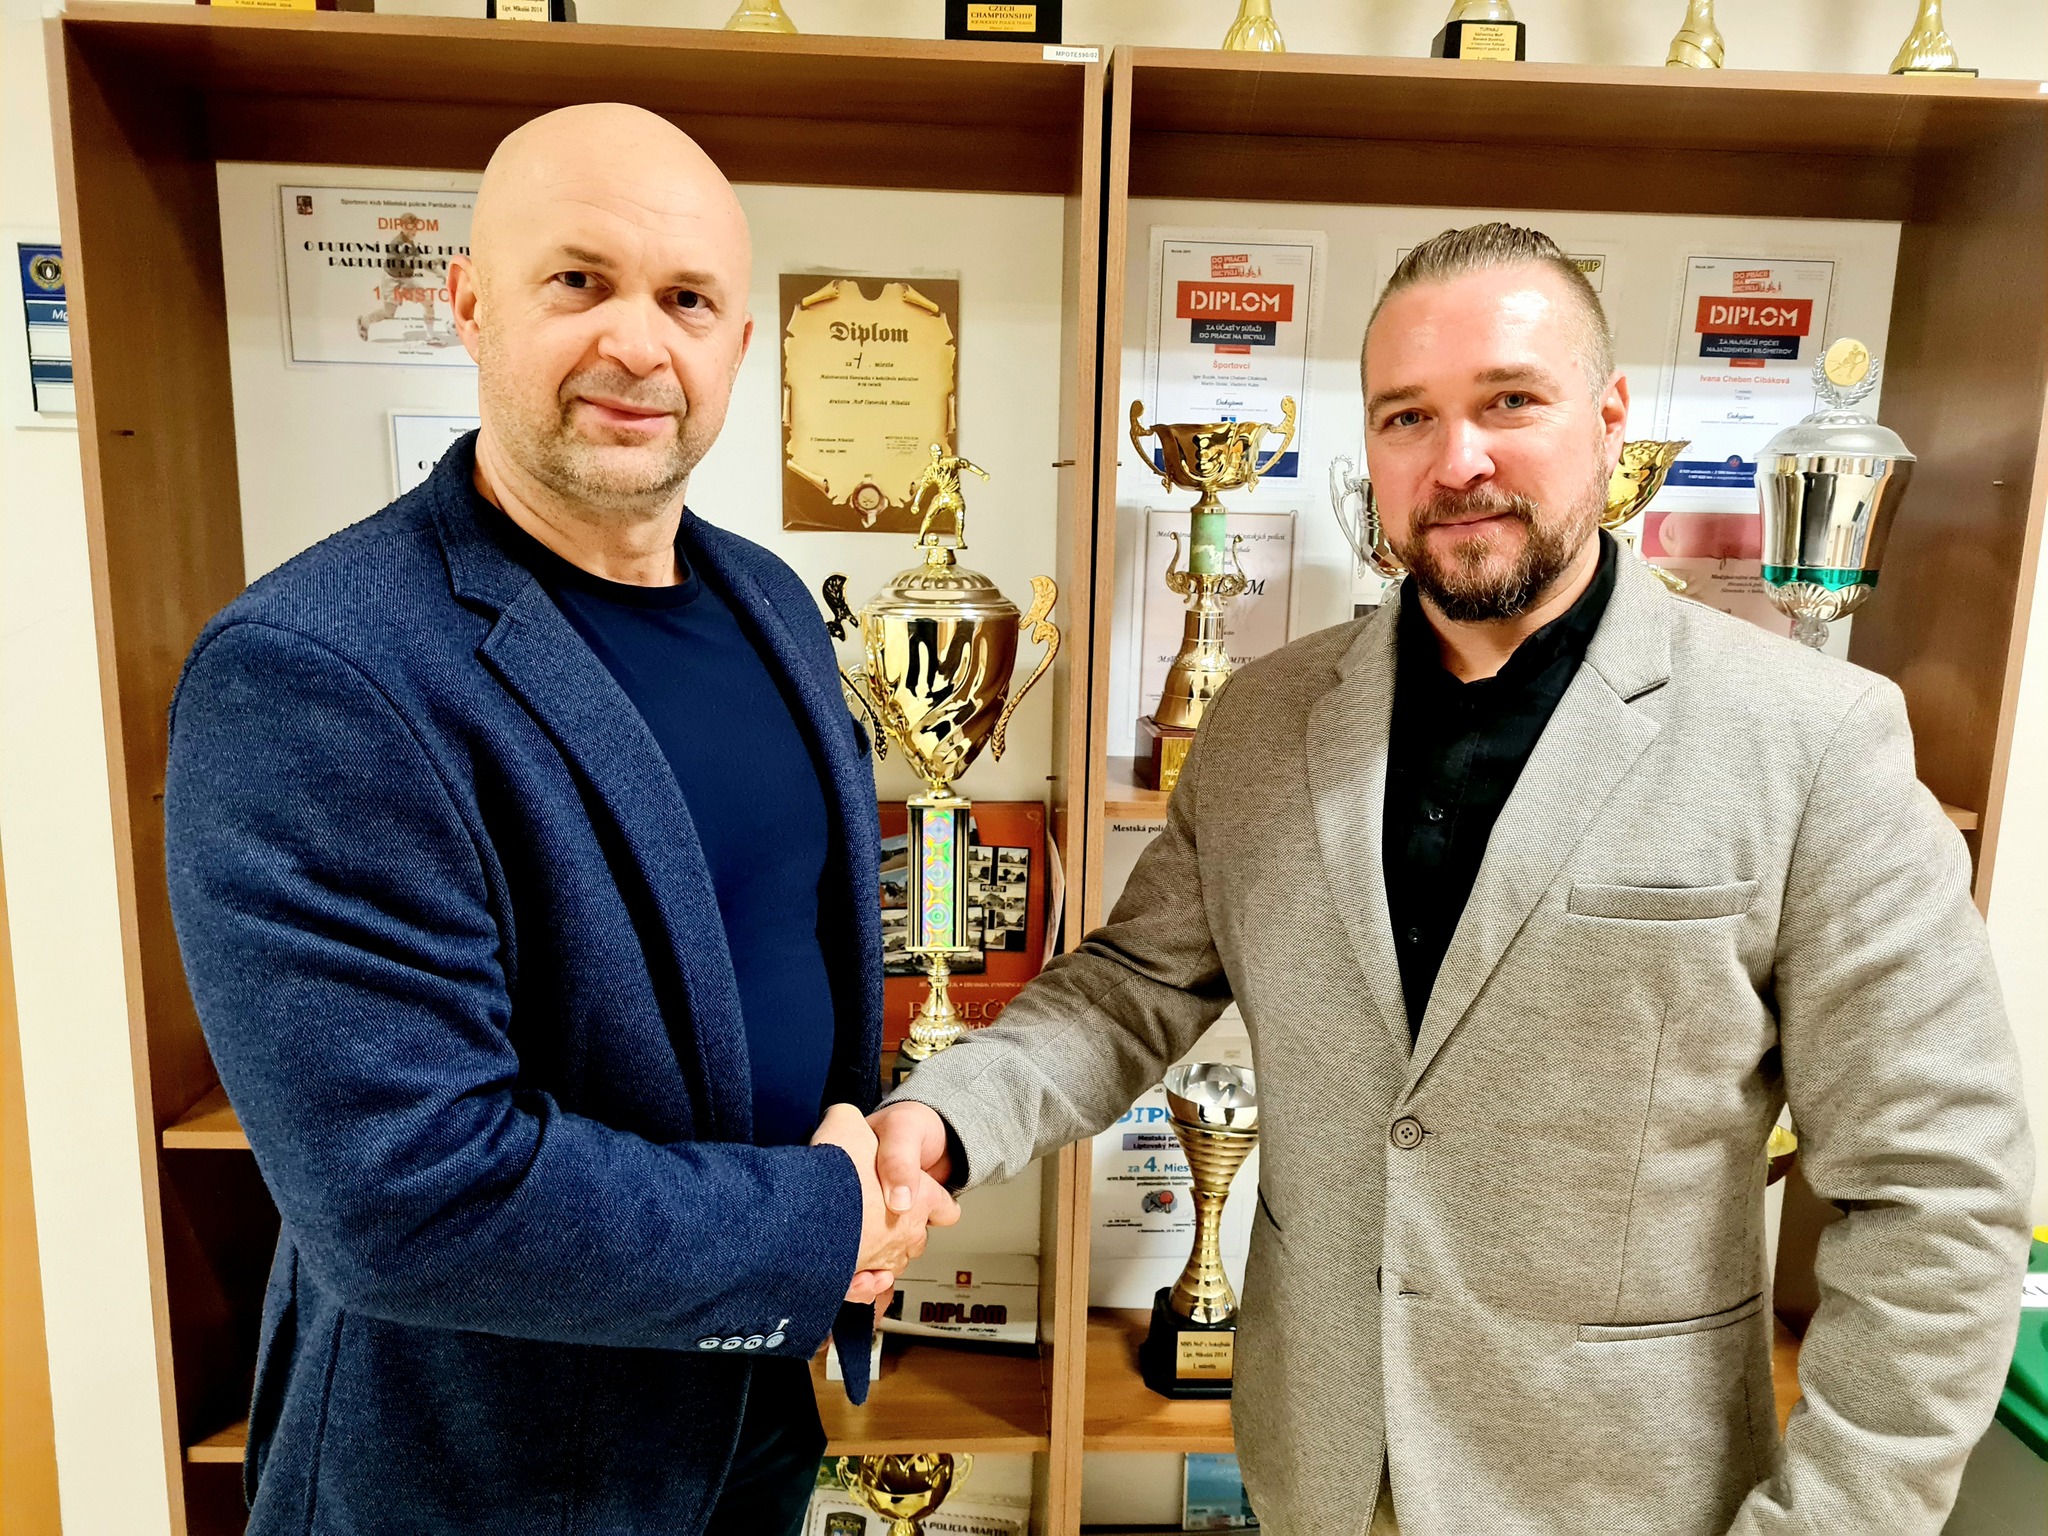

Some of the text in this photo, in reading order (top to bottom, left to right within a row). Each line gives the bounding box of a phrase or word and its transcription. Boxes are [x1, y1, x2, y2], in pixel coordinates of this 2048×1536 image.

[1190, 290, 1280, 312] DIPLOM
[1709, 305, 1798, 327] DIPLOM
[830, 321, 908, 347] Diplom
[1212, 360, 1250, 370] Športovci
[1754, 376, 1790, 384] Cibáková
[1164, 1164, 1189, 1172] Mies
[920, 1302, 1007, 1325] DIPLOM
[930, 1522, 967, 1533] POLÍCIA
